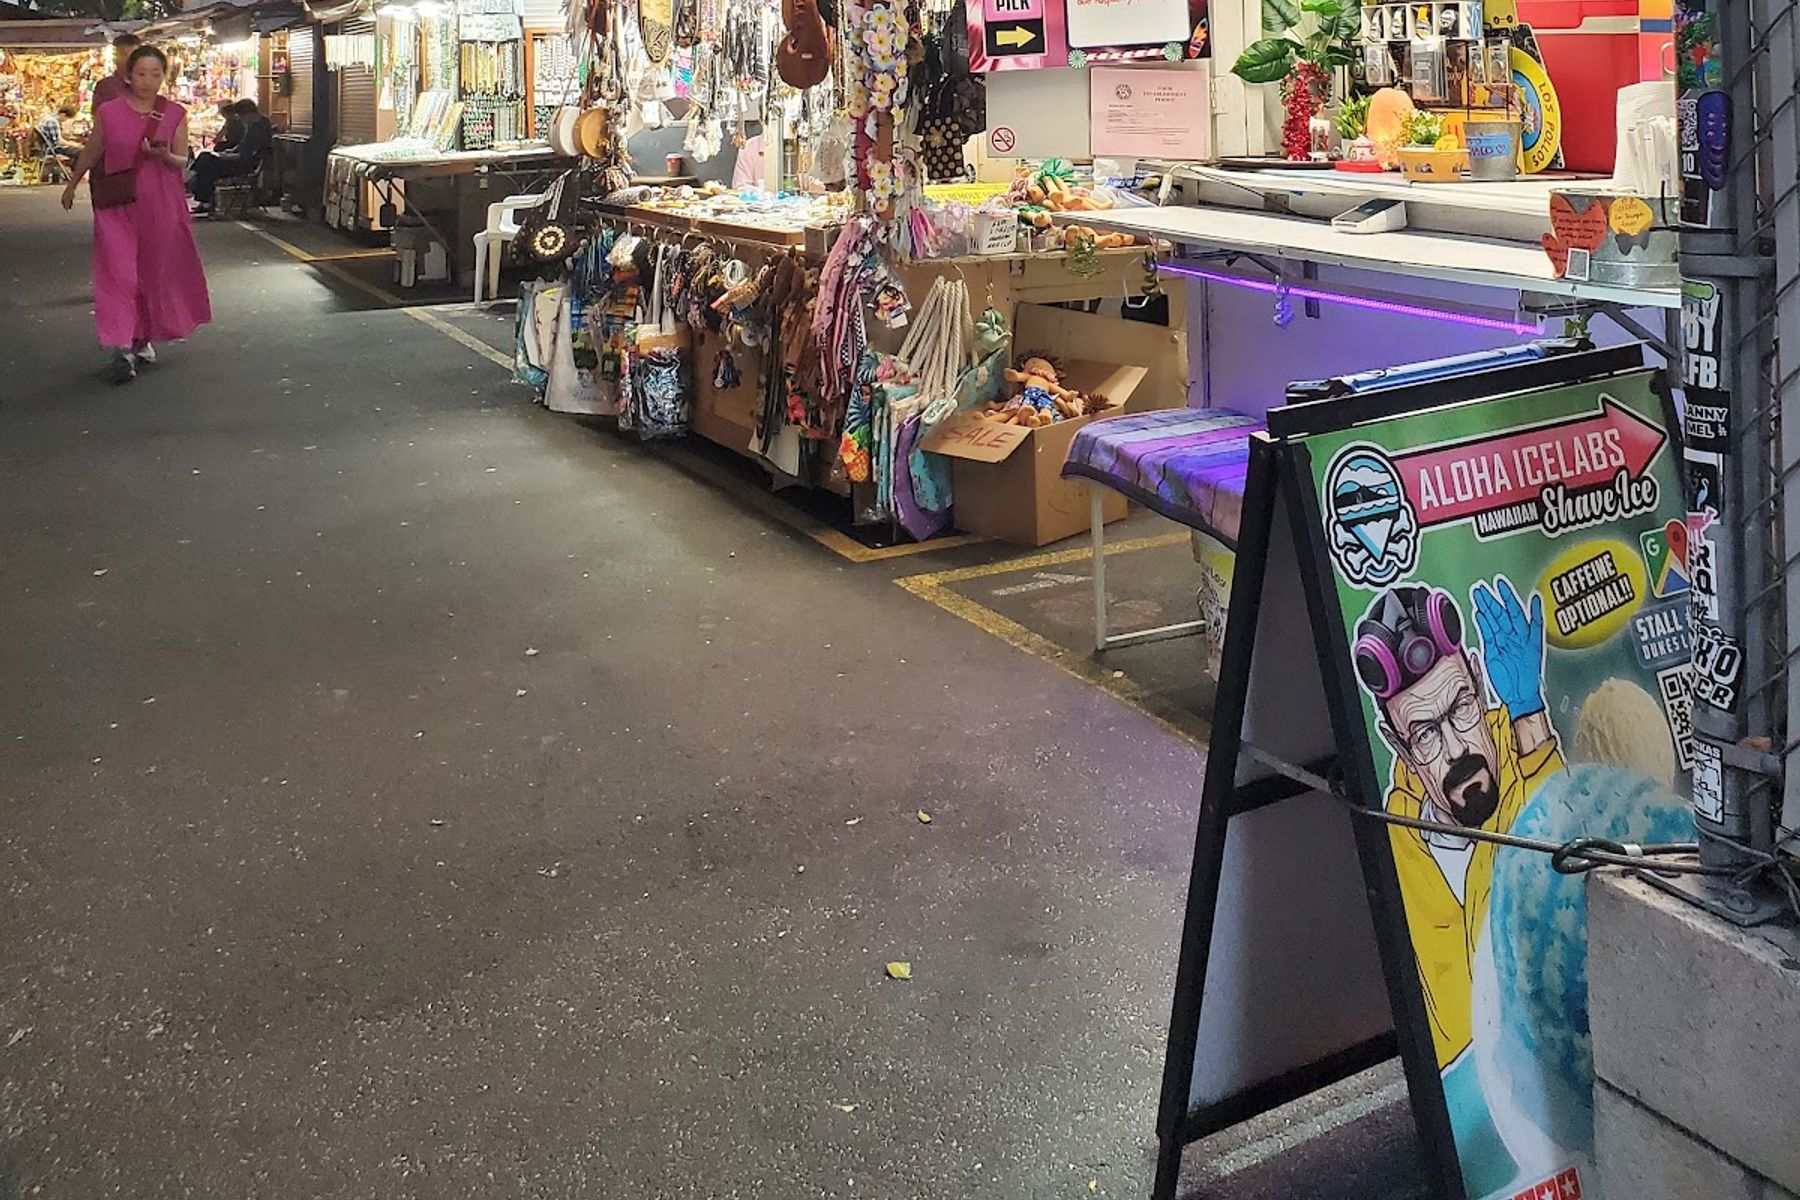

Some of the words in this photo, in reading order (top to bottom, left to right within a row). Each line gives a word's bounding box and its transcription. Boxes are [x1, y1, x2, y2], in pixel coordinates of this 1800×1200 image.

[1539, 82, 1554, 113] LOS
[1532, 121, 1555, 167] POLLOS
[950, 426, 1016, 448] SALE
[1419, 452, 1512, 511] ALOHA
[1512, 428, 1626, 488] ICELABS
[1477, 502, 1539, 534] HAWAIIAN
[1542, 487, 1617, 529] Shave
[1615, 470, 1655, 508] Ice
[1551, 553, 1616, 603] CAFFEINE
[1556, 577, 1633, 633] OPTIONAL!!
[1636, 609, 1683, 641] STALL
[1642, 636, 1680, 660] DUKES
